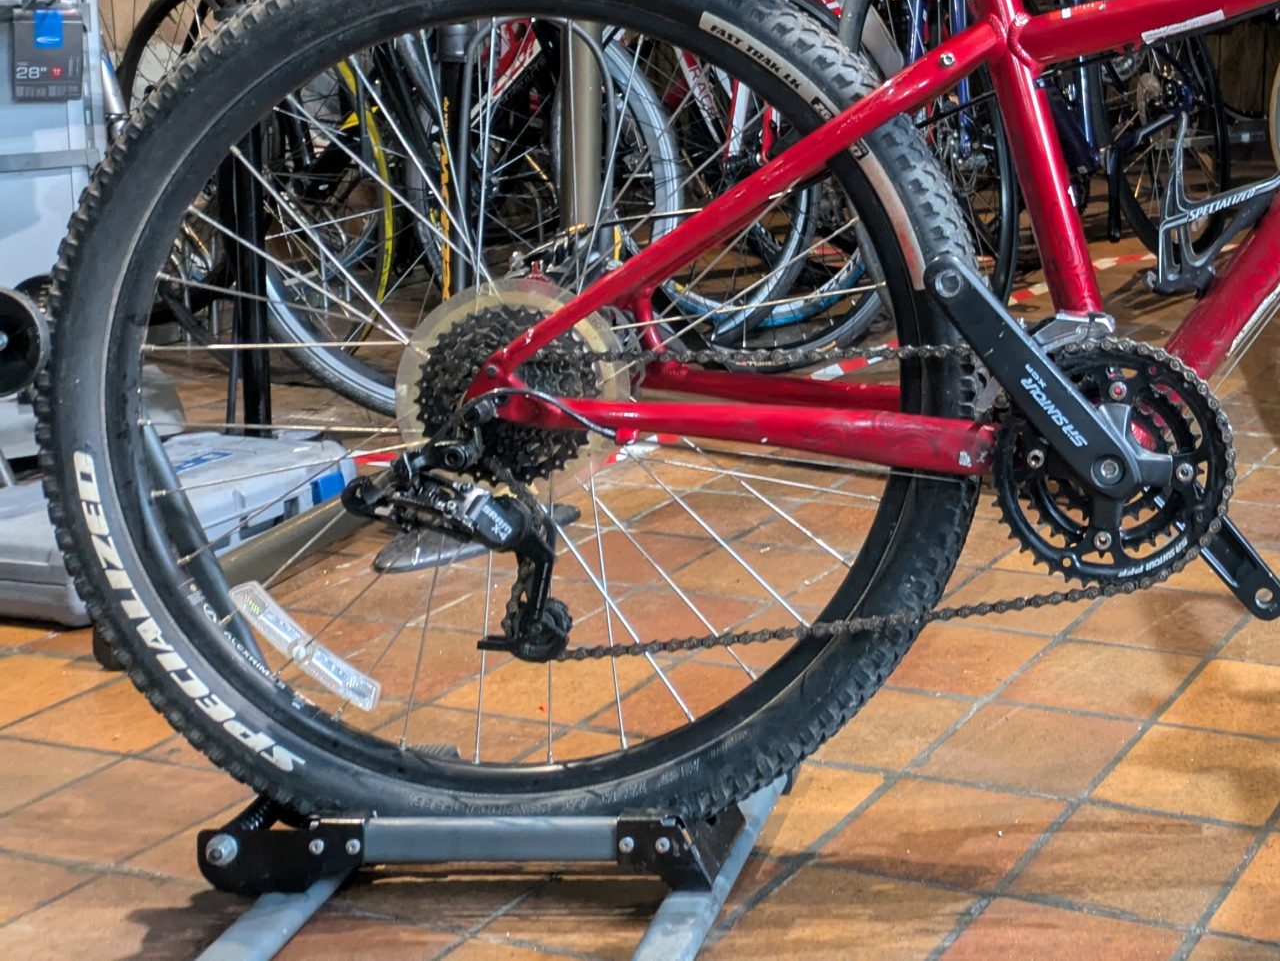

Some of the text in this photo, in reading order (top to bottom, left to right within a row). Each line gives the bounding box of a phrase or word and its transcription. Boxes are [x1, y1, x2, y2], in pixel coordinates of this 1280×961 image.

[709, 24, 743, 46] FAST
[745, 44, 782, 74] TRAK
[782, 73, 801, 90] LK
[1188, 187, 1258, 220] SPECIALIZED
[1024, 363, 1048, 389] XCR
[1020, 378, 1089, 448] SR SUNTOUR
[490, 523, 508, 541] X4
[1145, 548, 1176, 572] SUNTOUR
[73, 450, 306, 771] SPECIALIZED
